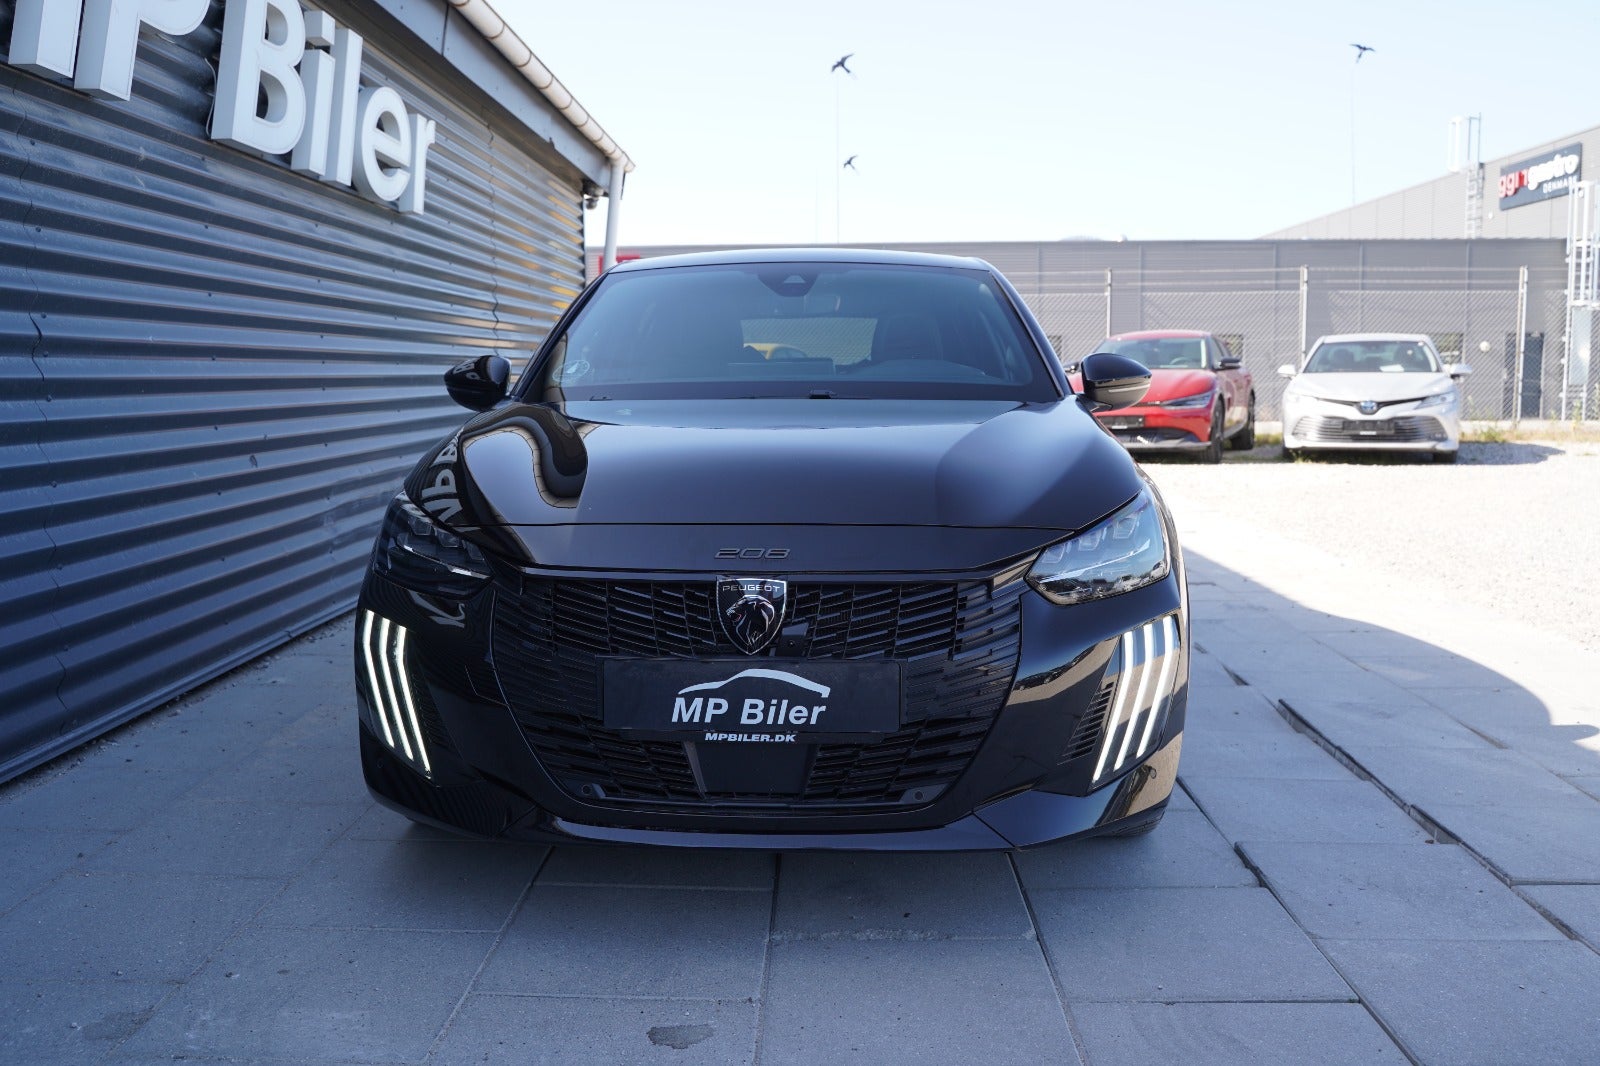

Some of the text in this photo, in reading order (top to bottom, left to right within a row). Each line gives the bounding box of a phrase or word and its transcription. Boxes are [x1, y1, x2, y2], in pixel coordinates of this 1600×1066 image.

[211, 0, 437, 216] Biler
[714, 547, 791, 560] 208
[722, 584, 781, 592] PEUGEOT
[671, 697, 827, 726] MP Biler
[704, 732, 796, 743] MPBILER.DK
